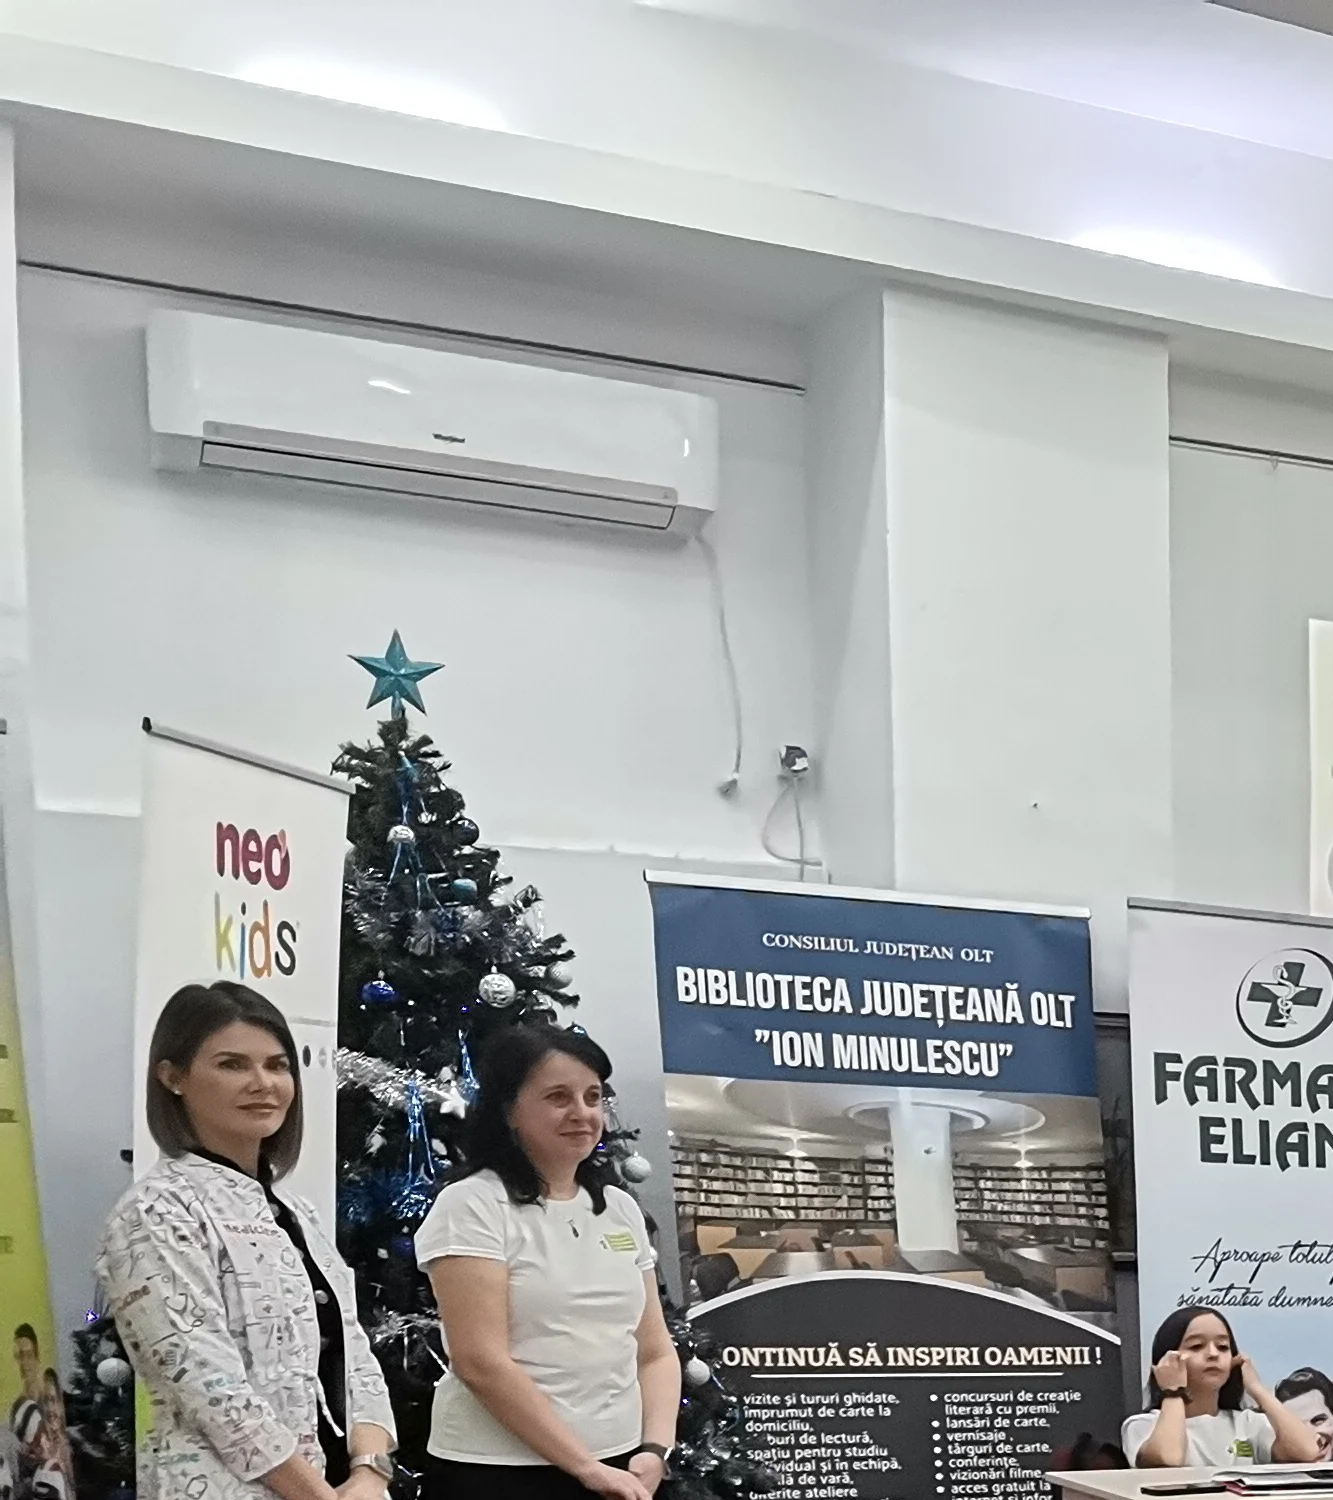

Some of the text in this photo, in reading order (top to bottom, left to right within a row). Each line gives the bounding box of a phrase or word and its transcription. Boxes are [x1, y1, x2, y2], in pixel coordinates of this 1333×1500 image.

[215, 820, 291, 891] neo
[213, 891, 297, 981] kids
[762, 932, 993, 963] CONSILIUL JUDEȚEAN OLT
[676, 966, 1075, 1028] BIBLIOTECA JUDEȚEANĂ OLT
[1191, 1237, 1283, 1284] Aproape
[722, 1342, 1102, 1367] ONTINUĂ SĂ INSPIRI OAMENII !
[743, 1393, 781, 1405] vizite
[784, 1393, 797, 1407] și
[800, 1393, 839, 1405] tururi
[944, 1390, 1082, 1404] concursuri de creație
[744, 1405, 892, 1421] împrumut de carte la
[945, 1403, 993, 1416] literară
[996, 1406, 1012, 1415] cu
[946, 1417, 990, 1429] lansări
[994, 1417, 1010, 1428] de
[798, 1432, 818, 1445] de
[947, 1430, 1006, 1443] vernisaje
[746, 1445, 889, 1462] spațiu pentru studiu
[996, 1442, 1014, 1454] de
[820, 1460, 833, 1475] și
[836, 1459, 850, 1472] în
[949, 1467, 1005, 1480] vizionări
[798, 1473, 818, 1486] de
[805, 1486, 858, 1499] ateliere
[951, 1480, 1052, 1495] acces gratuit la
